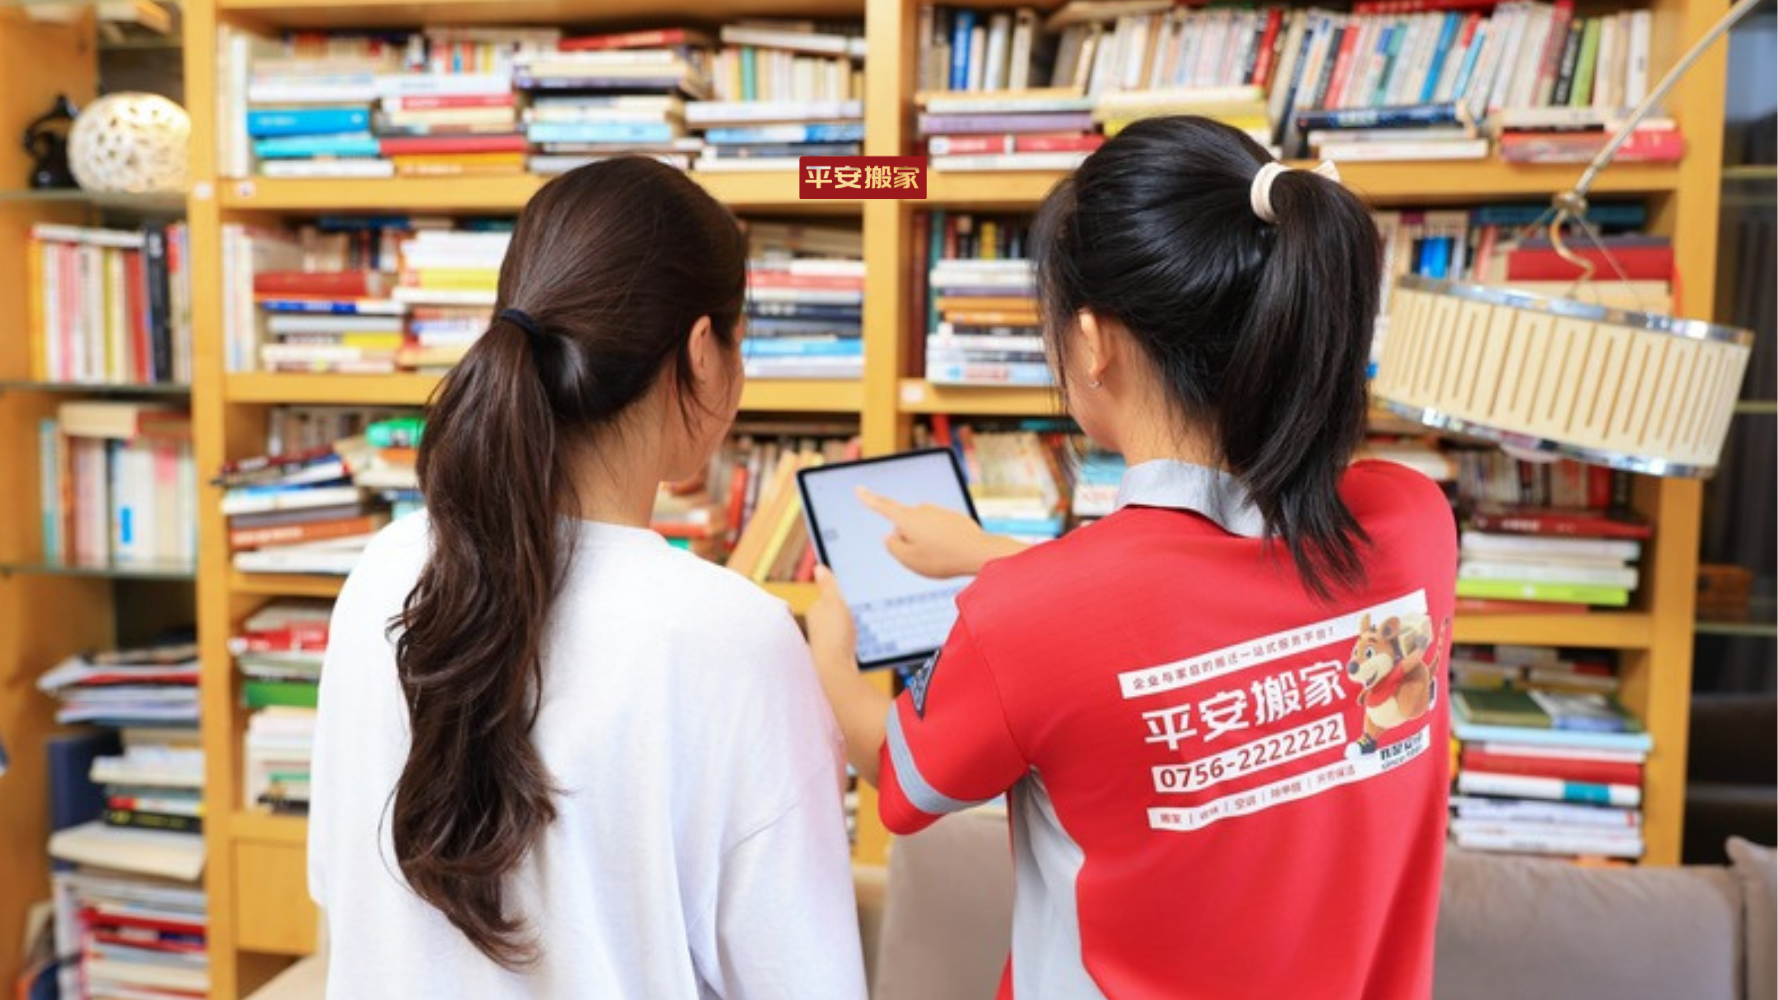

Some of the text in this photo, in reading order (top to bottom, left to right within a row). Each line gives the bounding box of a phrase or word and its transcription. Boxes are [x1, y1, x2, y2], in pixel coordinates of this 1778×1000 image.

[1141, 659, 1346, 750] 平安搬家
[1160, 718, 1341, 788] 0756-2222222
